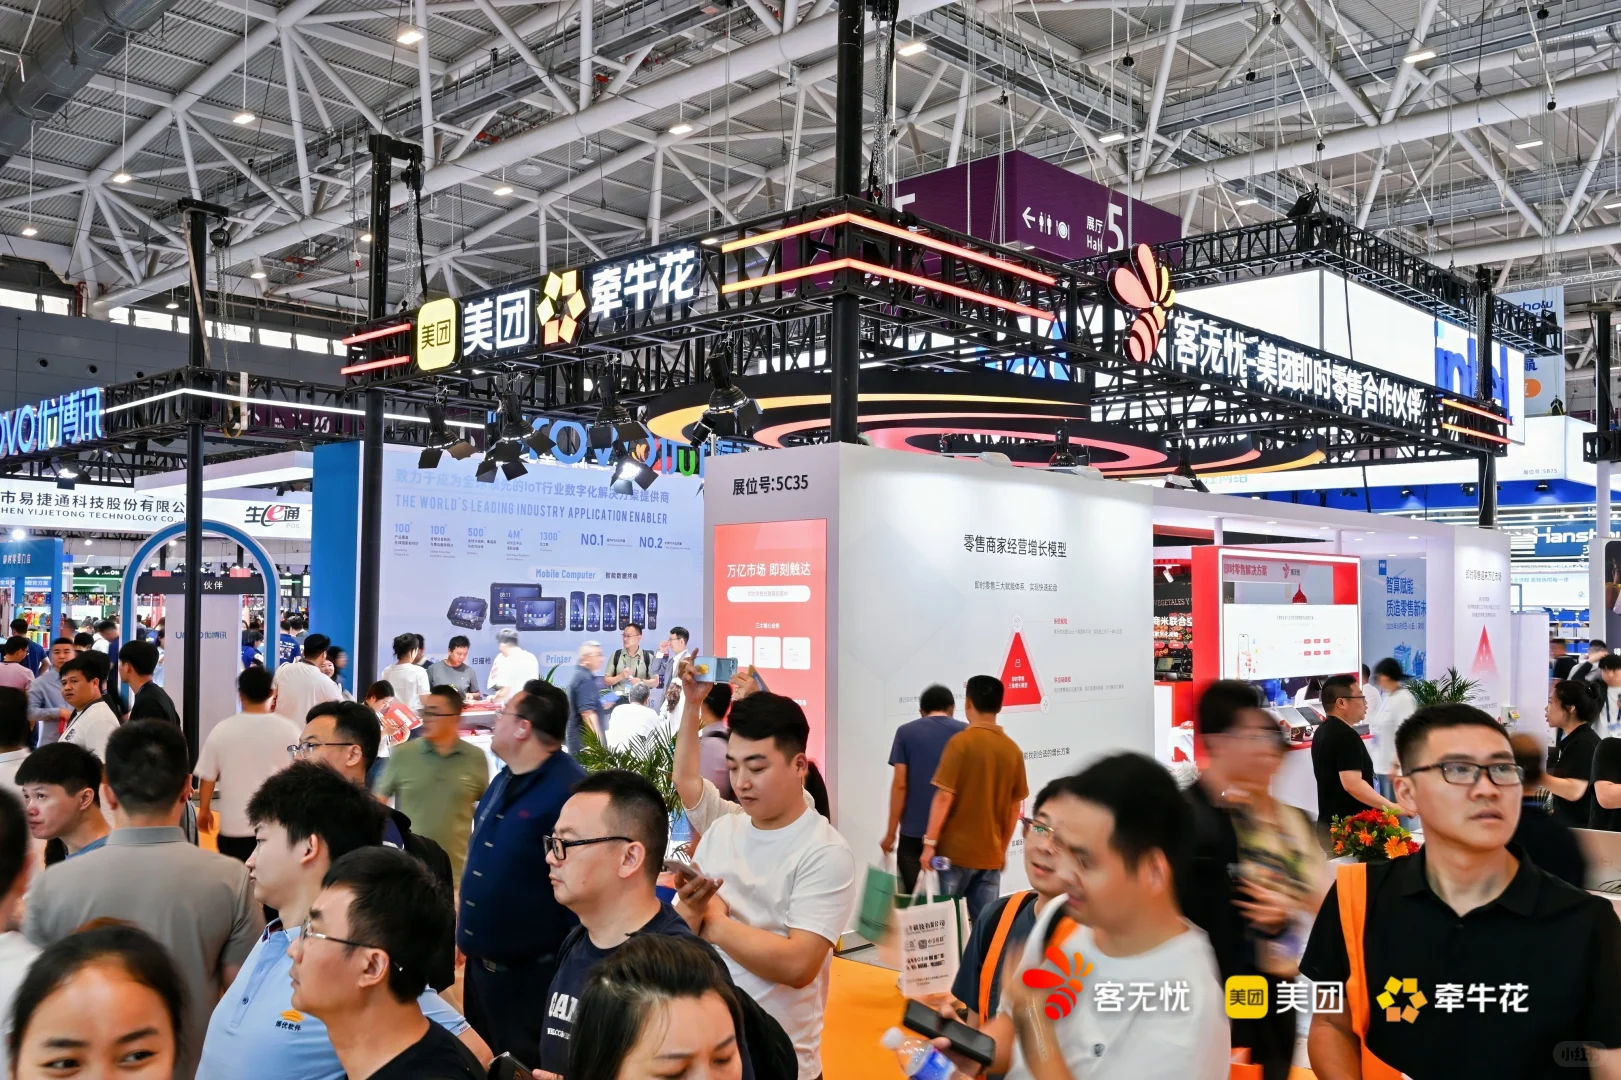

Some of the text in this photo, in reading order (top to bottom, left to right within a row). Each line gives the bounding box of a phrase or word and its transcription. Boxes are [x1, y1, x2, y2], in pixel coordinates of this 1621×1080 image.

[1087, 202, 1124, 254] 展厅 5
[1087, 234, 1103, 253] Hall
[421, 248, 696, 357] 美团 美团 牵牛花
[1174, 315, 1424, 424] 客无忧-美团即时零售合作伙伴
[733, 475, 808, 496] 展位号:5C35
[28, 507, 86, 518] YIJIETONG
[89, 511, 158, 522] TECHNOLOGY
[396, 494, 668, 525] THE WORLD'S LEADING INDUSTRY APPLICATION ENABLER
[581, 533, 604, 546] NO.1
[639, 536, 663, 549] NO.2
[964, 534, 1067, 558] 零售商家经营增长模型
[535, 568, 596, 581] Mobile Computer
[605, 571, 638, 580] 智能数据终端
[727, 561, 811, 578] 万亿市场 即刻触达
[1223, 563, 1268, 577] 即时零售解决方案
[1386, 576, 1414, 594] 智算赋能
[471, 657, 492, 665] 扫描枪
[545, 654, 572, 664] Printer
